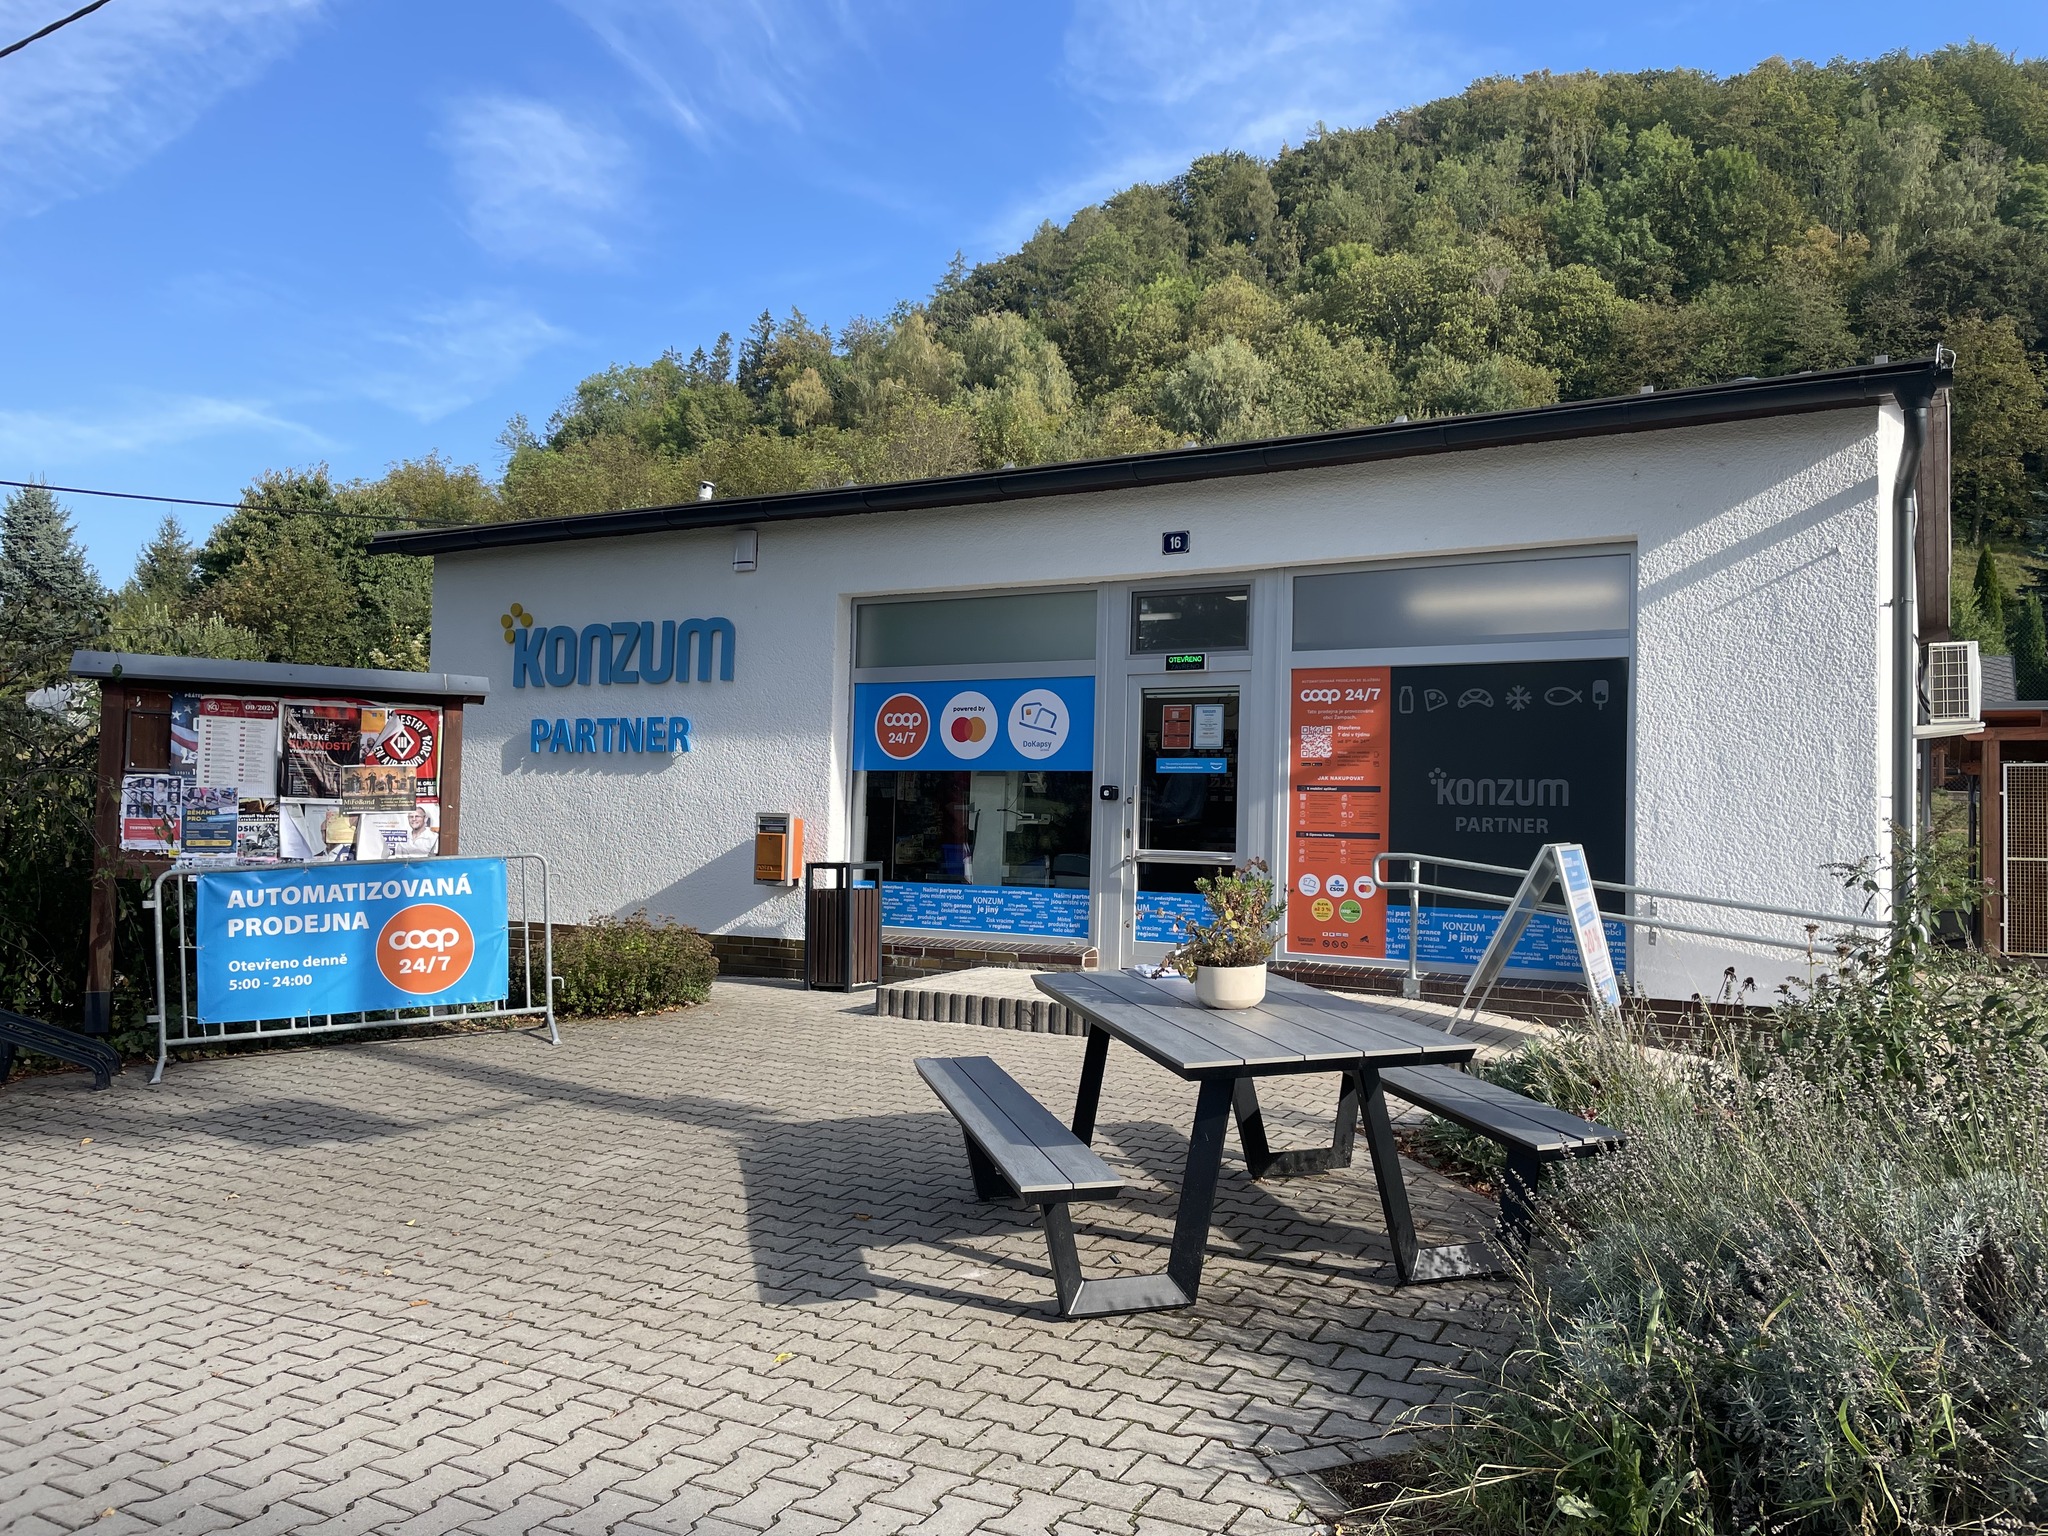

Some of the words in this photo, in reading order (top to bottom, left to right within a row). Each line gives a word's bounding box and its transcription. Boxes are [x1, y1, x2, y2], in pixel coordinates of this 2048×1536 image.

[1170, 536, 1181, 549] 16
[513, 617, 736, 688] KONZUM
[1168, 655, 1202, 663] OTEVŘENO
[1300, 689, 1340, 704] coop
[1345, 688, 1380, 701] 24/7
[884, 712, 922, 729] coop
[530, 716, 692, 753] PARTNER
[888, 732, 916, 744] 24/7
[1022, 740, 1052, 748] DoKapsy
[1437, 779, 1569, 806] KONZUM
[1456, 817, 1548, 834] PARTNER
[227, 873, 472, 908] AUTOMATIZOVANÁ
[972, 897, 1004, 905] KONZUM
[977, 906, 984, 914] je
[985, 906, 999, 915] jiný
[228, 912, 369, 937] PRODEJNA
[1442, 922, 1485, 932] KONZUM
[389, 928, 459, 952] coop
[1448, 932, 1458, 942] je
[1459, 932, 1478, 943] jiný
[228, 958, 299, 972] Otevřeno
[302, 954, 348, 967] denně
[400, 956, 450, 974] 24/7
[229, 978, 260, 990] 5:00
[272, 974, 312, 988] 24:00
